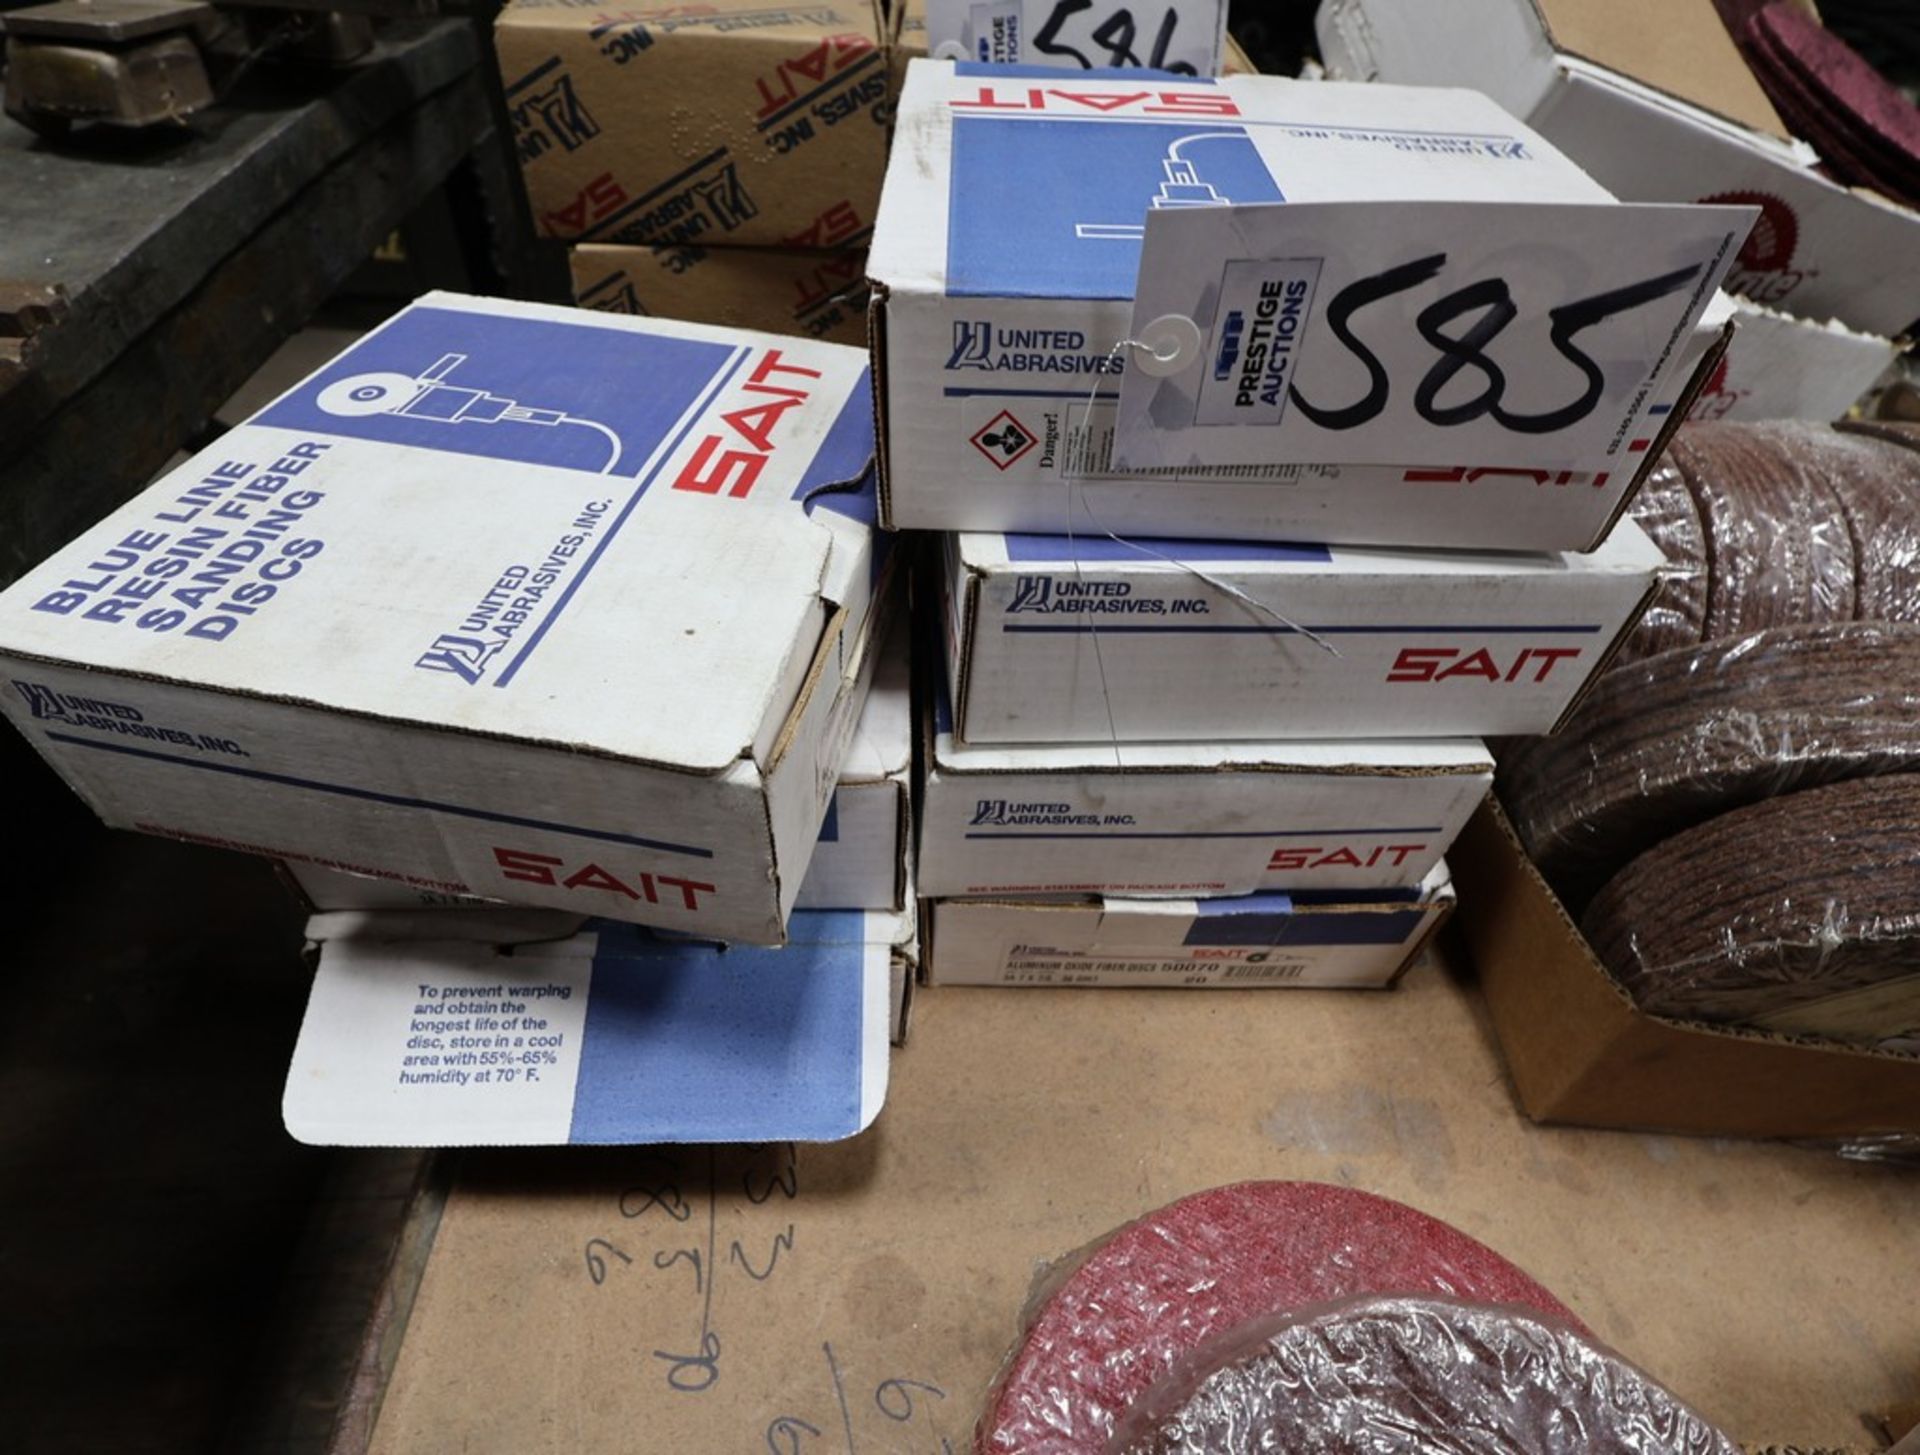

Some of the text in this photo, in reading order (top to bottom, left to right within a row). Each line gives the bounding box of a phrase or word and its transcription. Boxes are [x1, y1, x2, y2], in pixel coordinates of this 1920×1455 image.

[755, 33, 874, 118] SAIT
[949, 87, 1242, 116] SAIT
[765, 117, 815, 154] INC.
[998, 329, 1085, 350] UNITED
[1235, 280, 1283, 406] PRESTIGE
[1260, 279, 1307, 406] AUCTIONS
[1289, 252, 1703, 434] 585
[671, 349, 822, 499] SAIT
[1039, 412, 1059, 469] Danger!
[31, 460, 257, 615] BLUE LINE
[83, 440, 333, 623] RESIN FIBER
[137, 489, 326, 633] SANDING
[491, 497, 614, 639] ABRASIVES, INC.
[184, 537, 324, 642] DISCS
[459, 564, 530, 633] UNITED
[1055, 581, 1131, 597] UNITED
[1051, 599, 1210, 615] ABRASIVES, INC.
[1385, 646, 1582, 683] SAIT
[56, 693, 144, 722] UNITED
[74, 713, 250, 757] ABRASIVES, INC.
[1005, 814, 1137, 827] ABRASIVES, INC.
[1008, 803, 1071, 814] UNITED
[1265, 844, 1427, 870] SAIT
[493, 847, 715, 911] SAIT
[1044, 883, 1106, 892] STATEMENT
[1006, 961, 1062, 970] ALUMINUM
[1064, 962, 1093, 971] OXIDE
[1096, 962, 1126, 972] FIBER
[1127, 962, 1158, 972] DISCS
[413, 1001, 526, 1015] and obtain the
[418, 984, 572, 1000] To prevent warping
[406, 1033, 564, 1050] disc, store in a cool
[409, 1017, 548, 1034] longest life of the
[402, 1051, 557, 1067] area with 55%-65%
[399, 1068, 540, 1086] humidity at 70° F.
